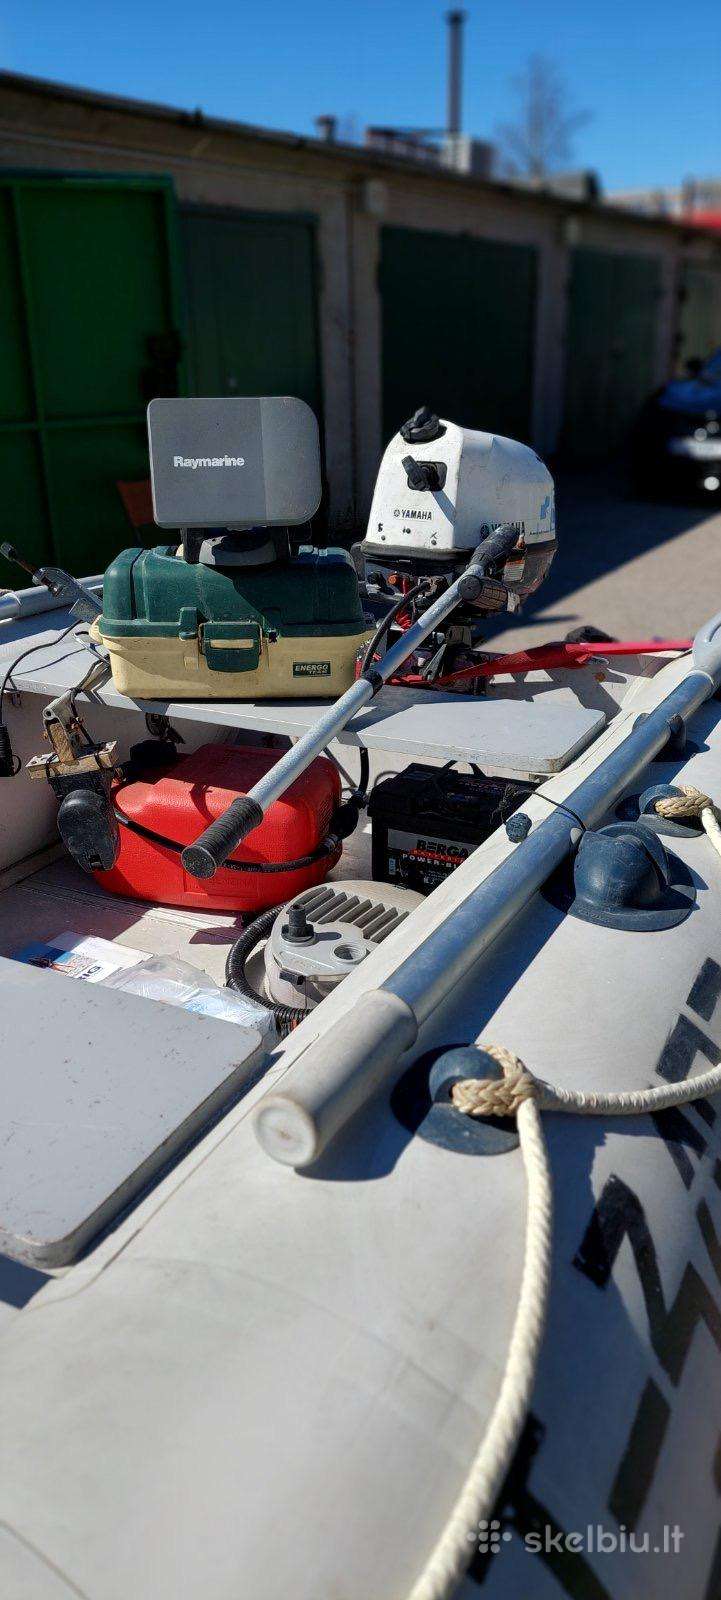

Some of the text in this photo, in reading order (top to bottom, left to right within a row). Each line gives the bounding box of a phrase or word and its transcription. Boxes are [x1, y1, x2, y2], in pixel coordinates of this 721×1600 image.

[173, 454, 246, 470] Raymarine
[401, 509, 432, 521] YAMAHA
[294, 663, 329, 672] ENERGO
[415, 839, 469, 857] BERGA
